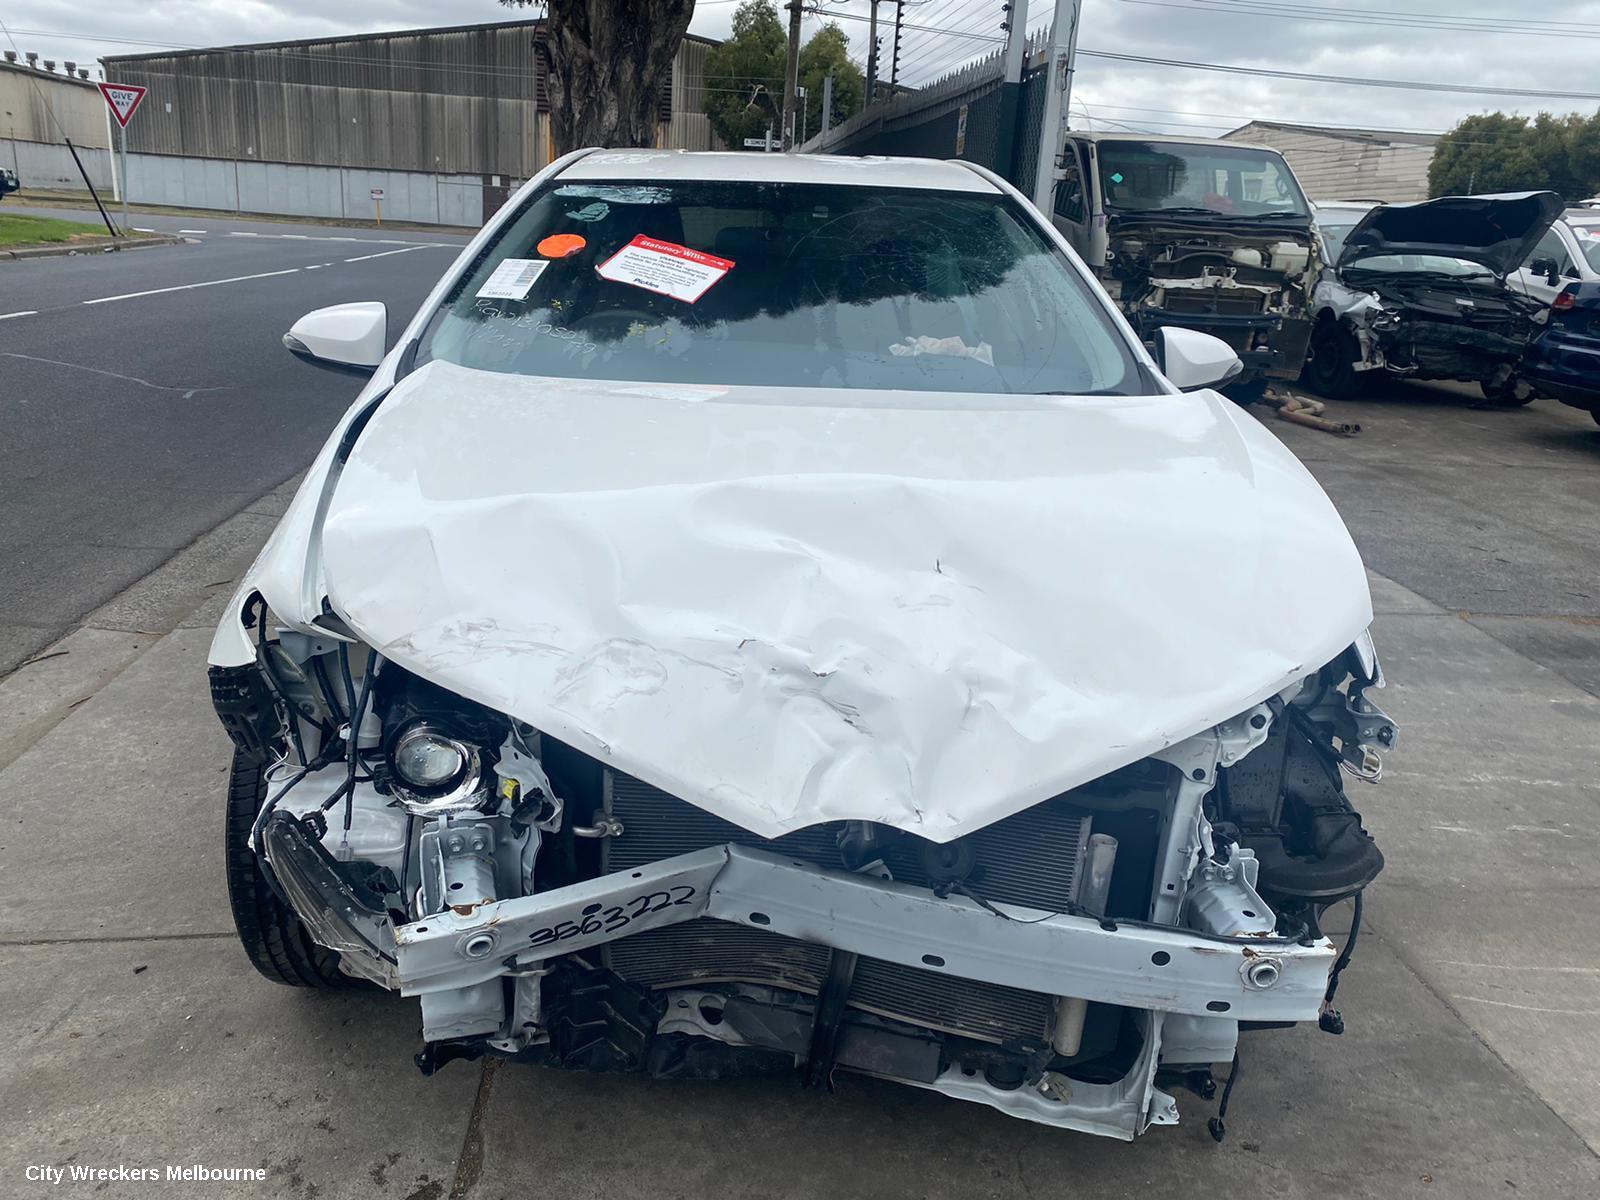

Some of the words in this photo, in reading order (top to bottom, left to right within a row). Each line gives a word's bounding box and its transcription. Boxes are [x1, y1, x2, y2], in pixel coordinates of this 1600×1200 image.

[111, 91, 133, 100] GIVE
[640, 240, 681, 255] Statutory
[633, 277, 660, 289] Pickles
